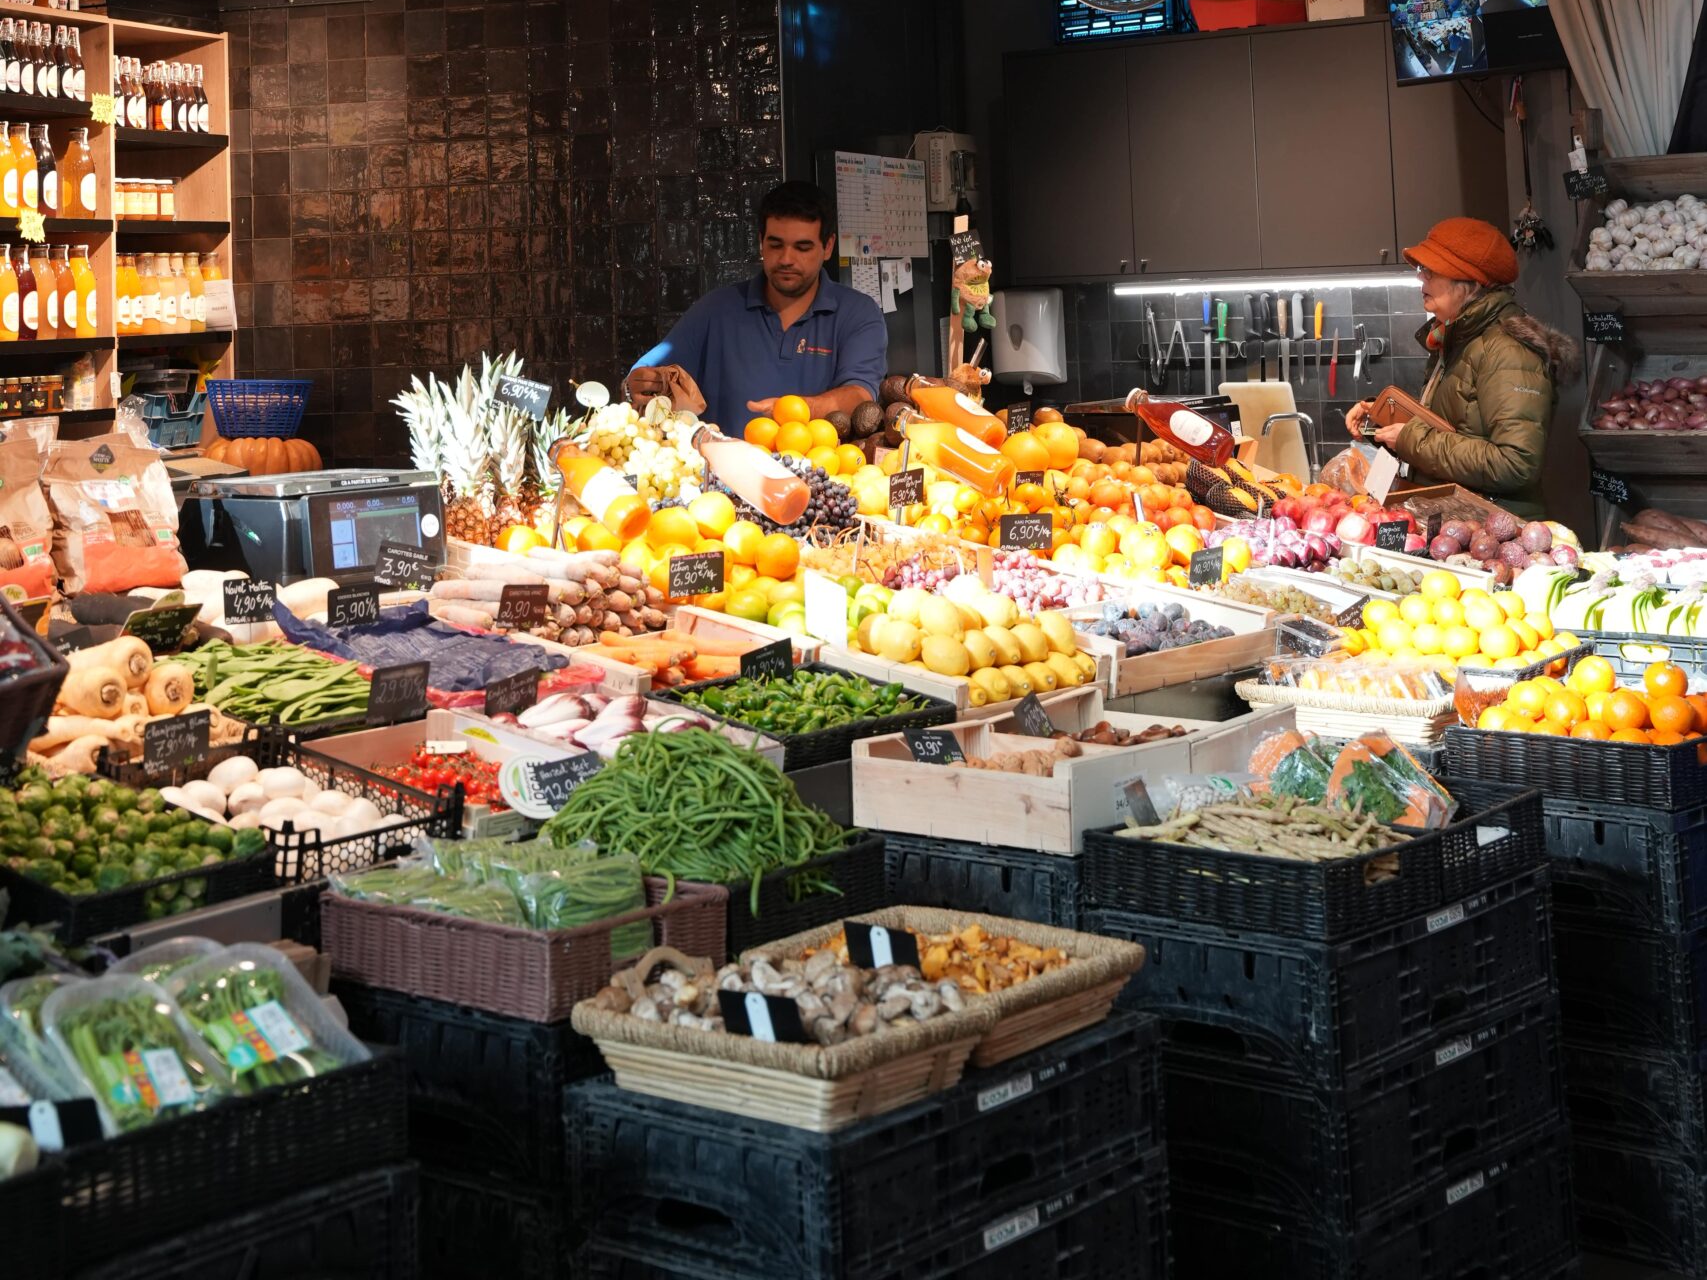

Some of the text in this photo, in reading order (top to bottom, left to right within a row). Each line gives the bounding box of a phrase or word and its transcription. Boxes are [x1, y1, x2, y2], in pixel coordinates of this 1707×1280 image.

[387, 548, 412, 558] CAROTTES
[381, 557, 419, 578] 3,90€
[671, 560, 708, 573] Citron Vert
